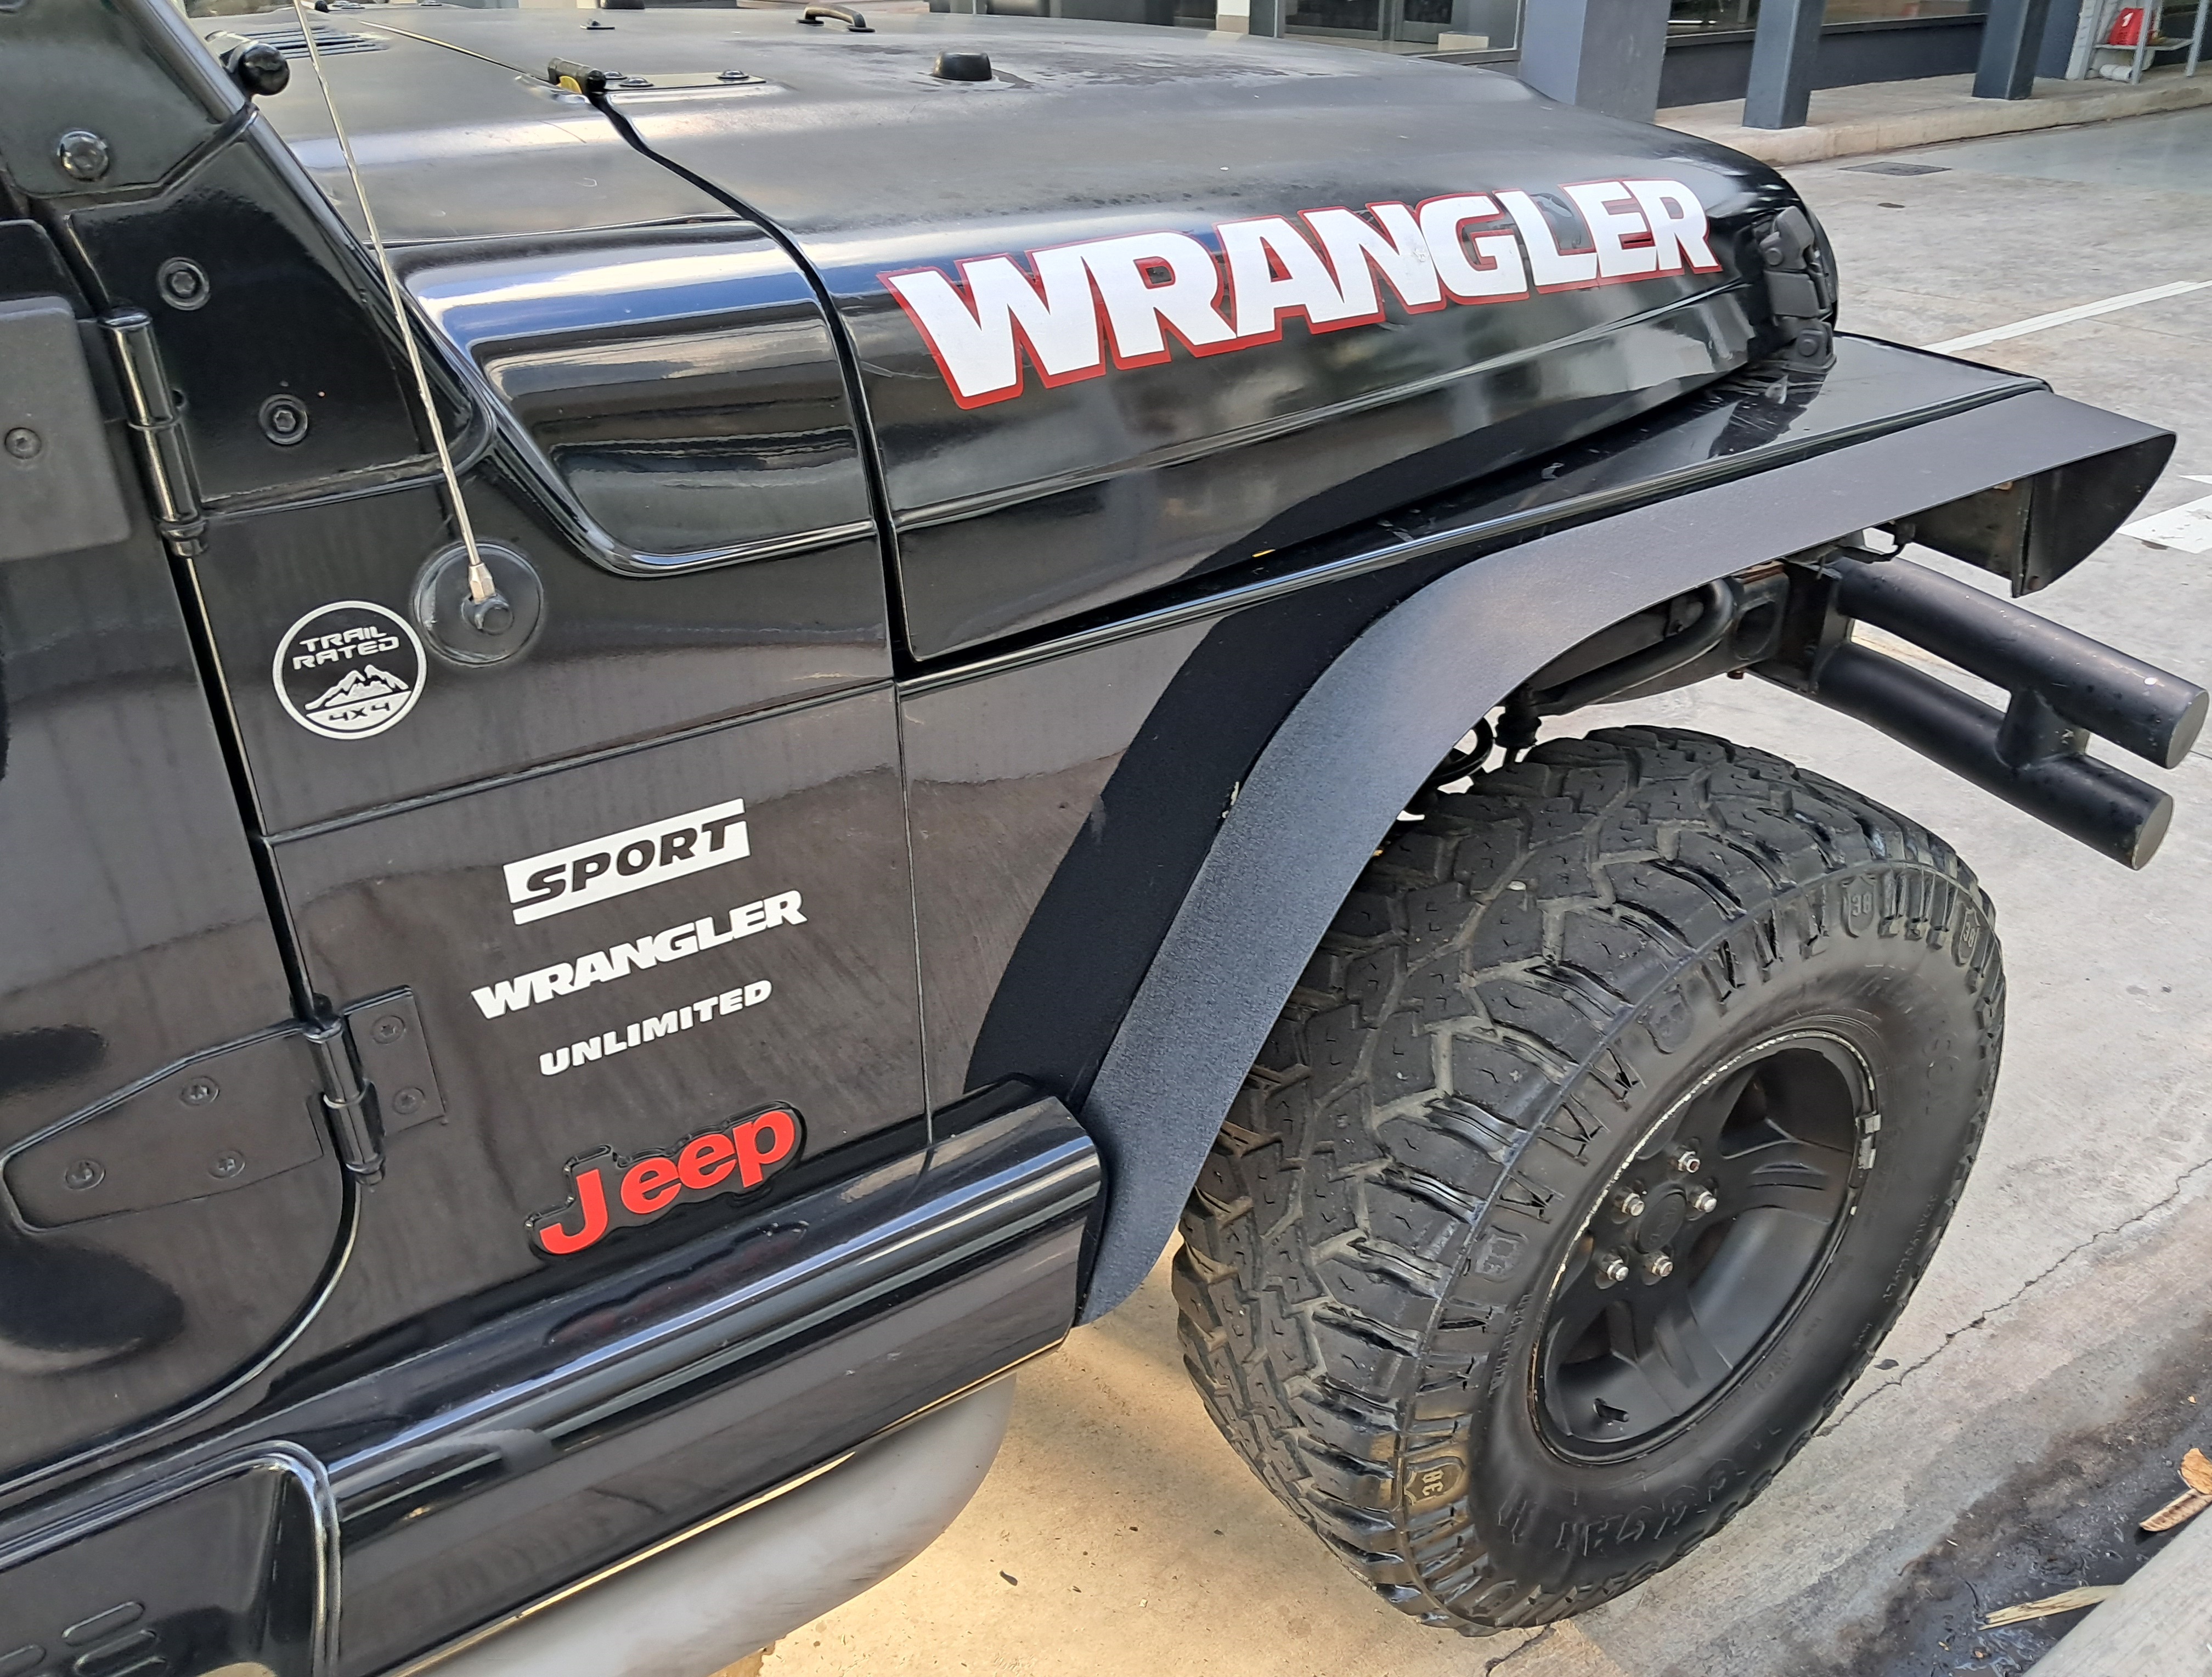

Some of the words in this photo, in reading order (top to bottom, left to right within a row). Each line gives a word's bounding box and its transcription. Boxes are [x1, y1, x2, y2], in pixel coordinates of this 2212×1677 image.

[878, 178, 1722, 409] WRANGLER
[292, 636, 400, 670] RATED
[299, 626, 387, 652] TRAIL
[525, 819, 739, 903] SPORT
[1850, 891, 1874, 917] 38
[471, 890, 808, 1019] WRANGLER
[539, 980, 772, 1076] UNLIMITED
[539, 1110, 795, 1255] Jeep
[1421, 1469, 1444, 1496] 38
